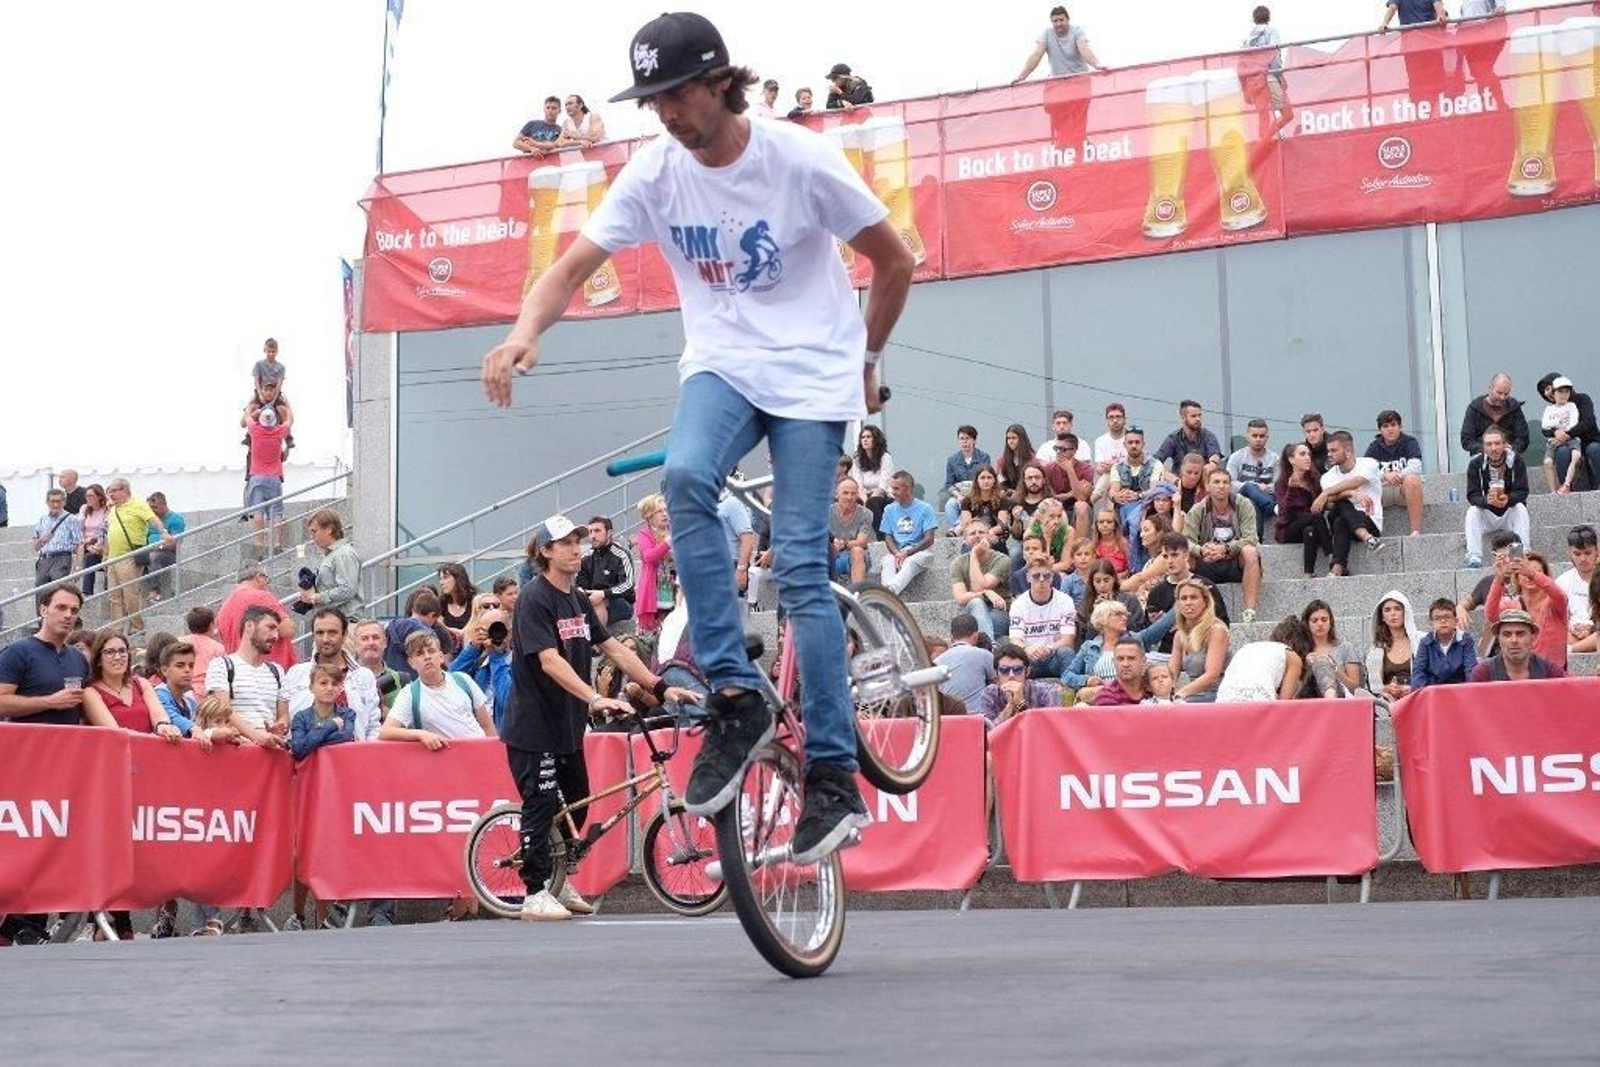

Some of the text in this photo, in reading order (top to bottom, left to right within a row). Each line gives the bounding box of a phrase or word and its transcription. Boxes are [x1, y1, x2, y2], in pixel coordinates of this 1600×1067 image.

[1300, 87, 1496, 134] Bock to the beat
[958, 135, 1131, 178] Bock to the beat
[420, 227, 437, 248] to
[443, 223, 469, 246] the
[476, 217, 516, 242] beat
[1060, 767, 1300, 810] NISSAN
[1469, 752, 1600, 795] NIS
[132, 805, 257, 843] NISSAN
